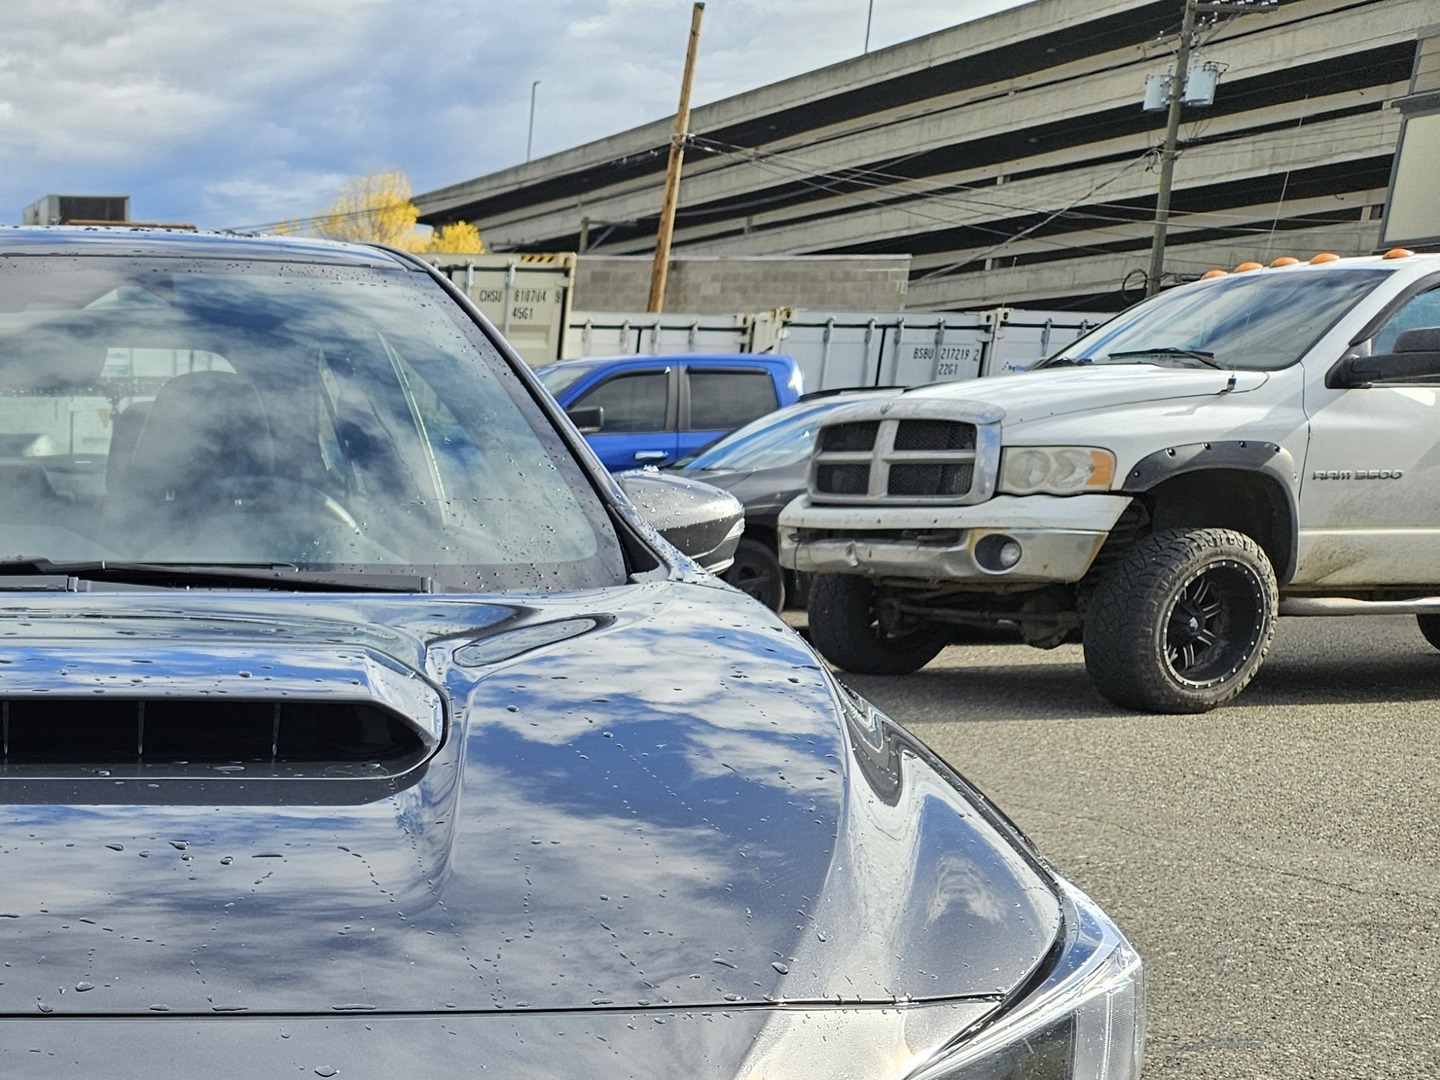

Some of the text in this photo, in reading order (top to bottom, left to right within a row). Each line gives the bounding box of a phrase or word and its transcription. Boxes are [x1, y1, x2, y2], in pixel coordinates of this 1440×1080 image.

[940, 348, 970, 360] 217219
[973, 349, 979, 361] 2
[938, 363, 958, 375] 22G1
[1312, 469, 1352, 480] RAM
